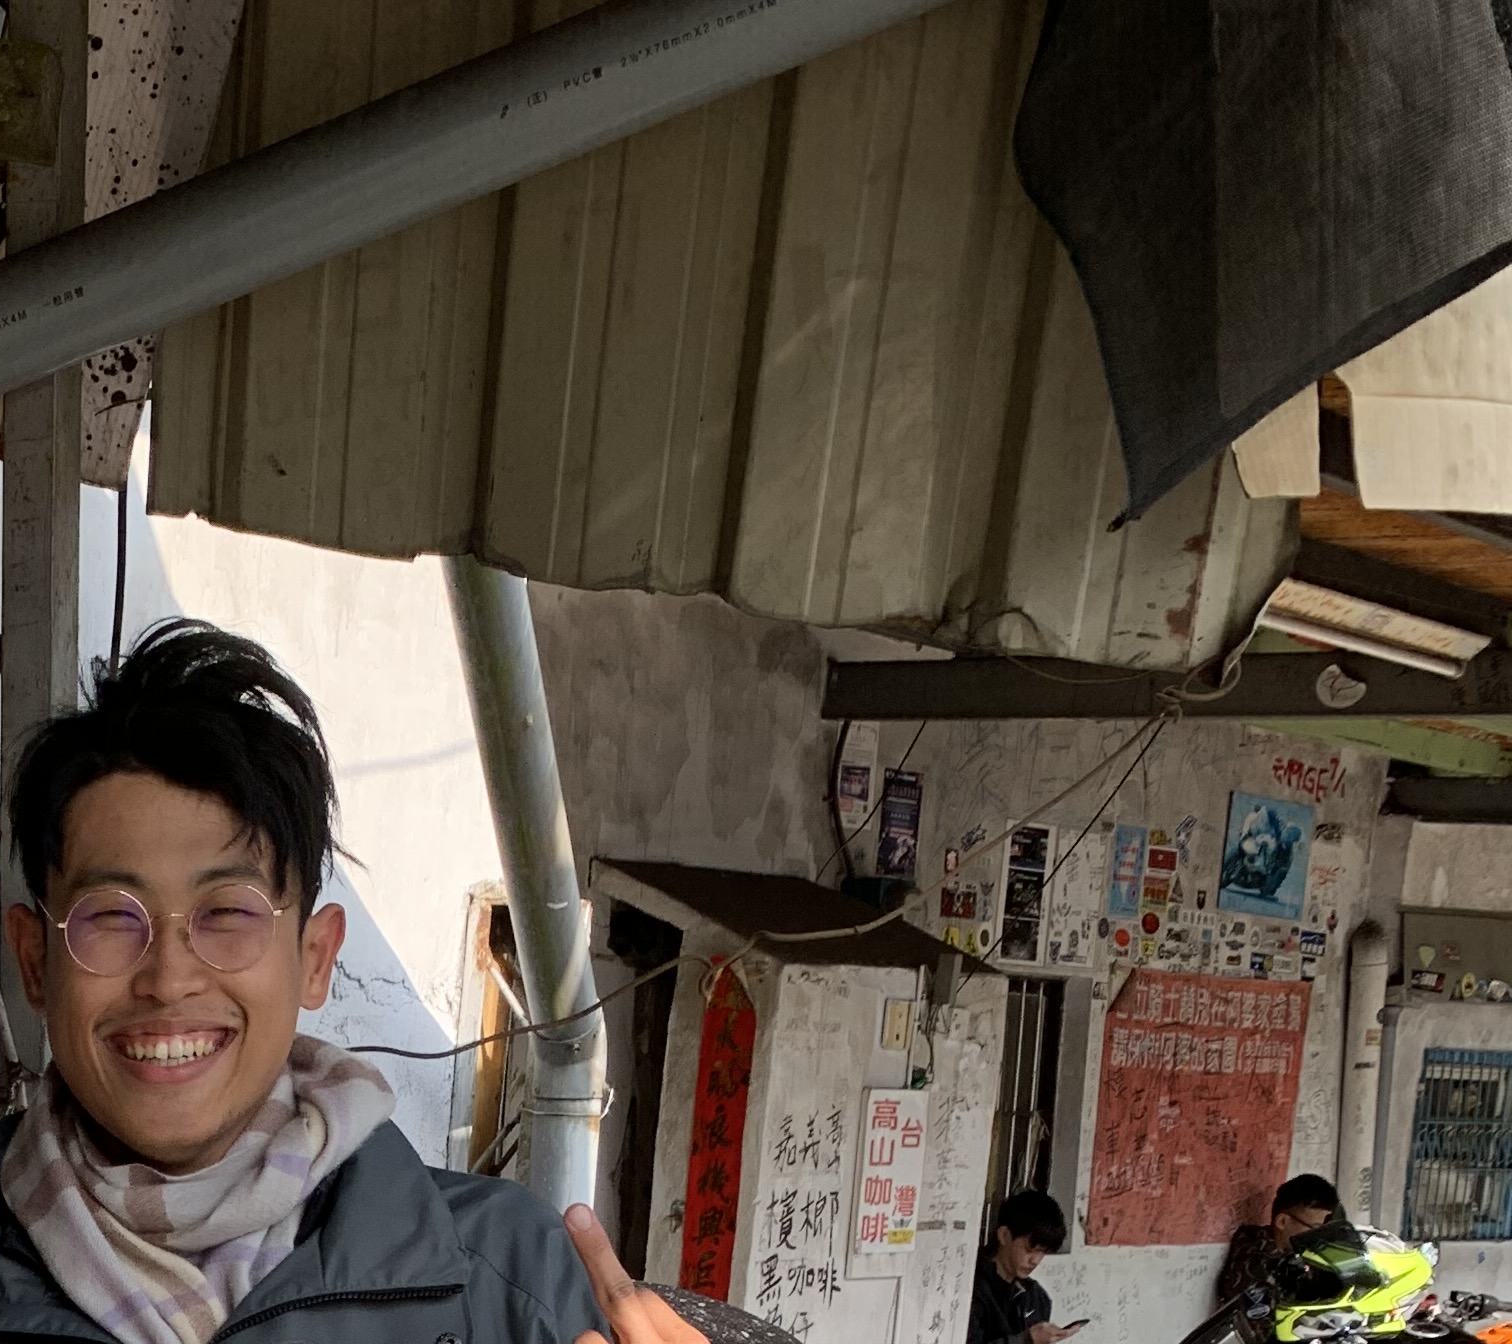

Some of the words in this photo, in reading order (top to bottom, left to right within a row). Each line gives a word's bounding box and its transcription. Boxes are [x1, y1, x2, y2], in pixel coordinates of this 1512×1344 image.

[773, 1110, 822, 1173] 嘉義
[861, 1098, 901, 1243] 高山咖啡
[892, 1116, 924, 1217] 台灣
[765, 1188, 840, 1257] 檳榔
[756, 1254, 841, 1310] 黑咖啡
